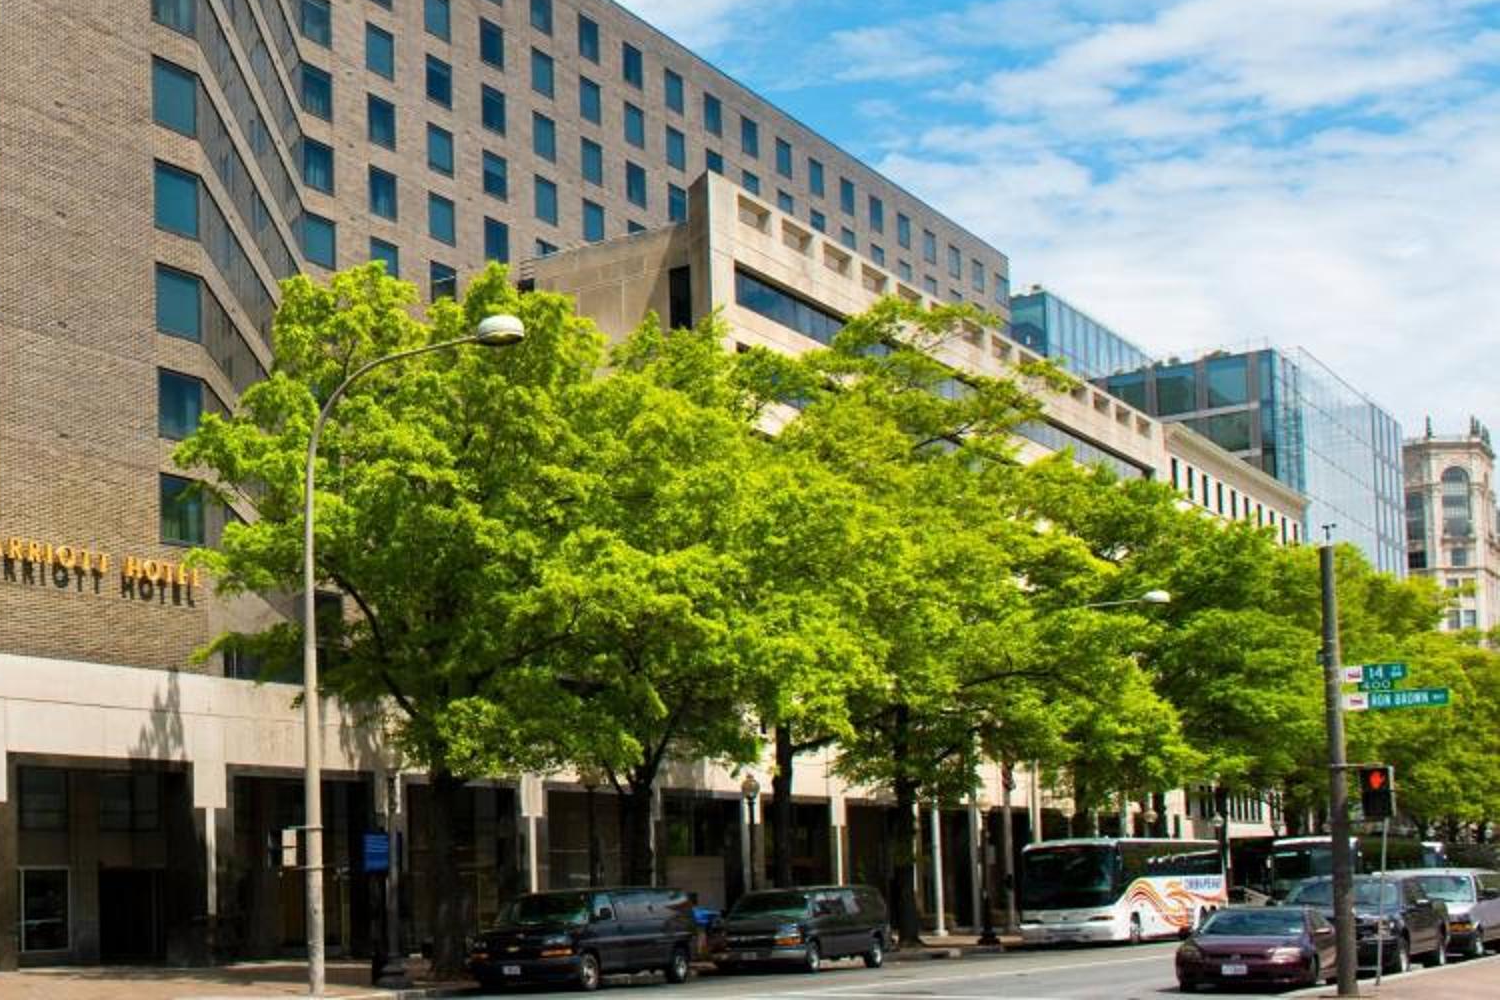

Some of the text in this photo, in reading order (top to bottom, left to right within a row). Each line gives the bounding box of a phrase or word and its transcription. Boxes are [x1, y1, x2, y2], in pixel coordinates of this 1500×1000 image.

[124, 555, 201, 588] HOTEL
[1369, 666, 1383, 679] 14
[1363, 680, 1391, 689] 400
[1371, 691, 1391, 706] RON
[1394, 690, 1429, 704] BROWN
